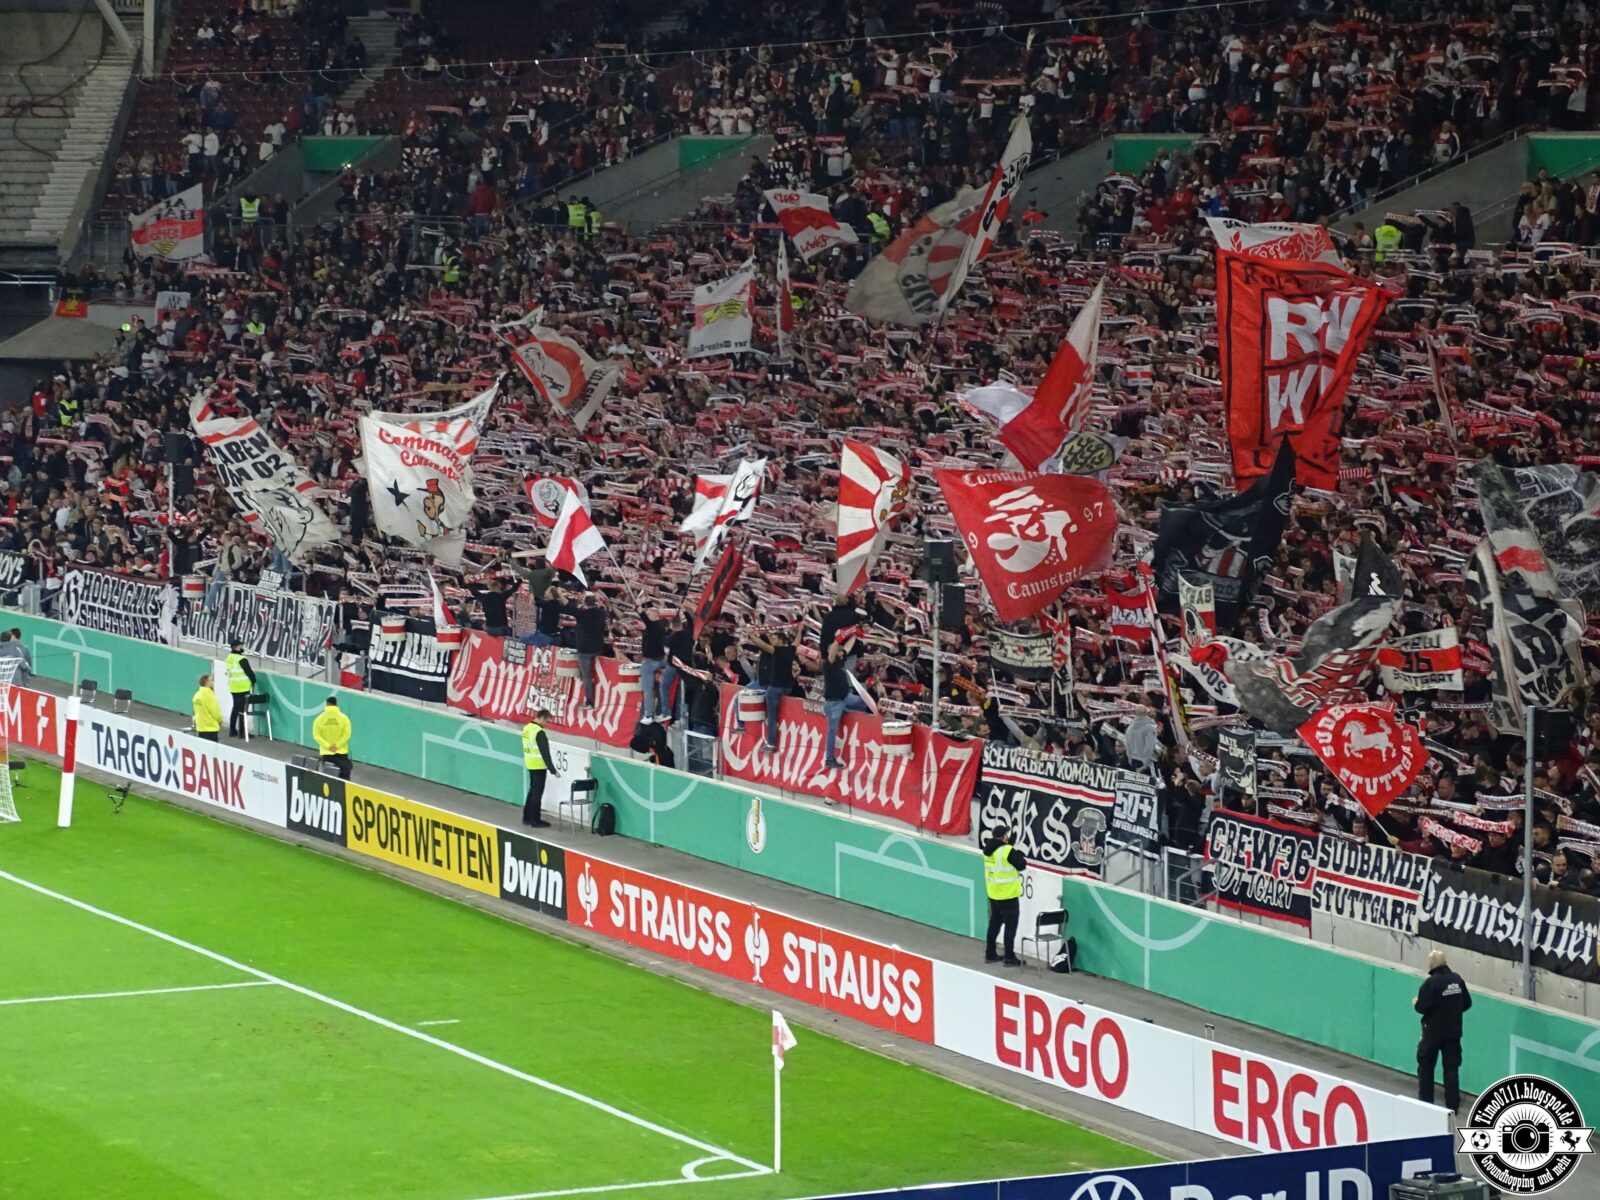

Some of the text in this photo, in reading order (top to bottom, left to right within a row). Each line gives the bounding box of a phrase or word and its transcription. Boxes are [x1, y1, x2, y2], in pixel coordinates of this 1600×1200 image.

[79, 603, 163, 643] STUTTGART
[80, 570, 162, 617] HOOLIGANS
[556, 750, 568, 772] 35
[921, 740, 973, 826] 97
[983, 744, 1055, 777] SCHWABEN
[289, 776, 342, 835] bwin
[352, 796, 493, 883] SPORTWETTEN
[1208, 817, 1315, 883] CREW 36
[502, 841, 563, 908] bwin
[1311, 880, 1418, 934] STUTTGART
[609, 879, 923, 1024] STRAUSS STRAUSS
[995, 985, 1129, 1100] ERGO
[1211, 1049, 1368, 1151] ERGO
